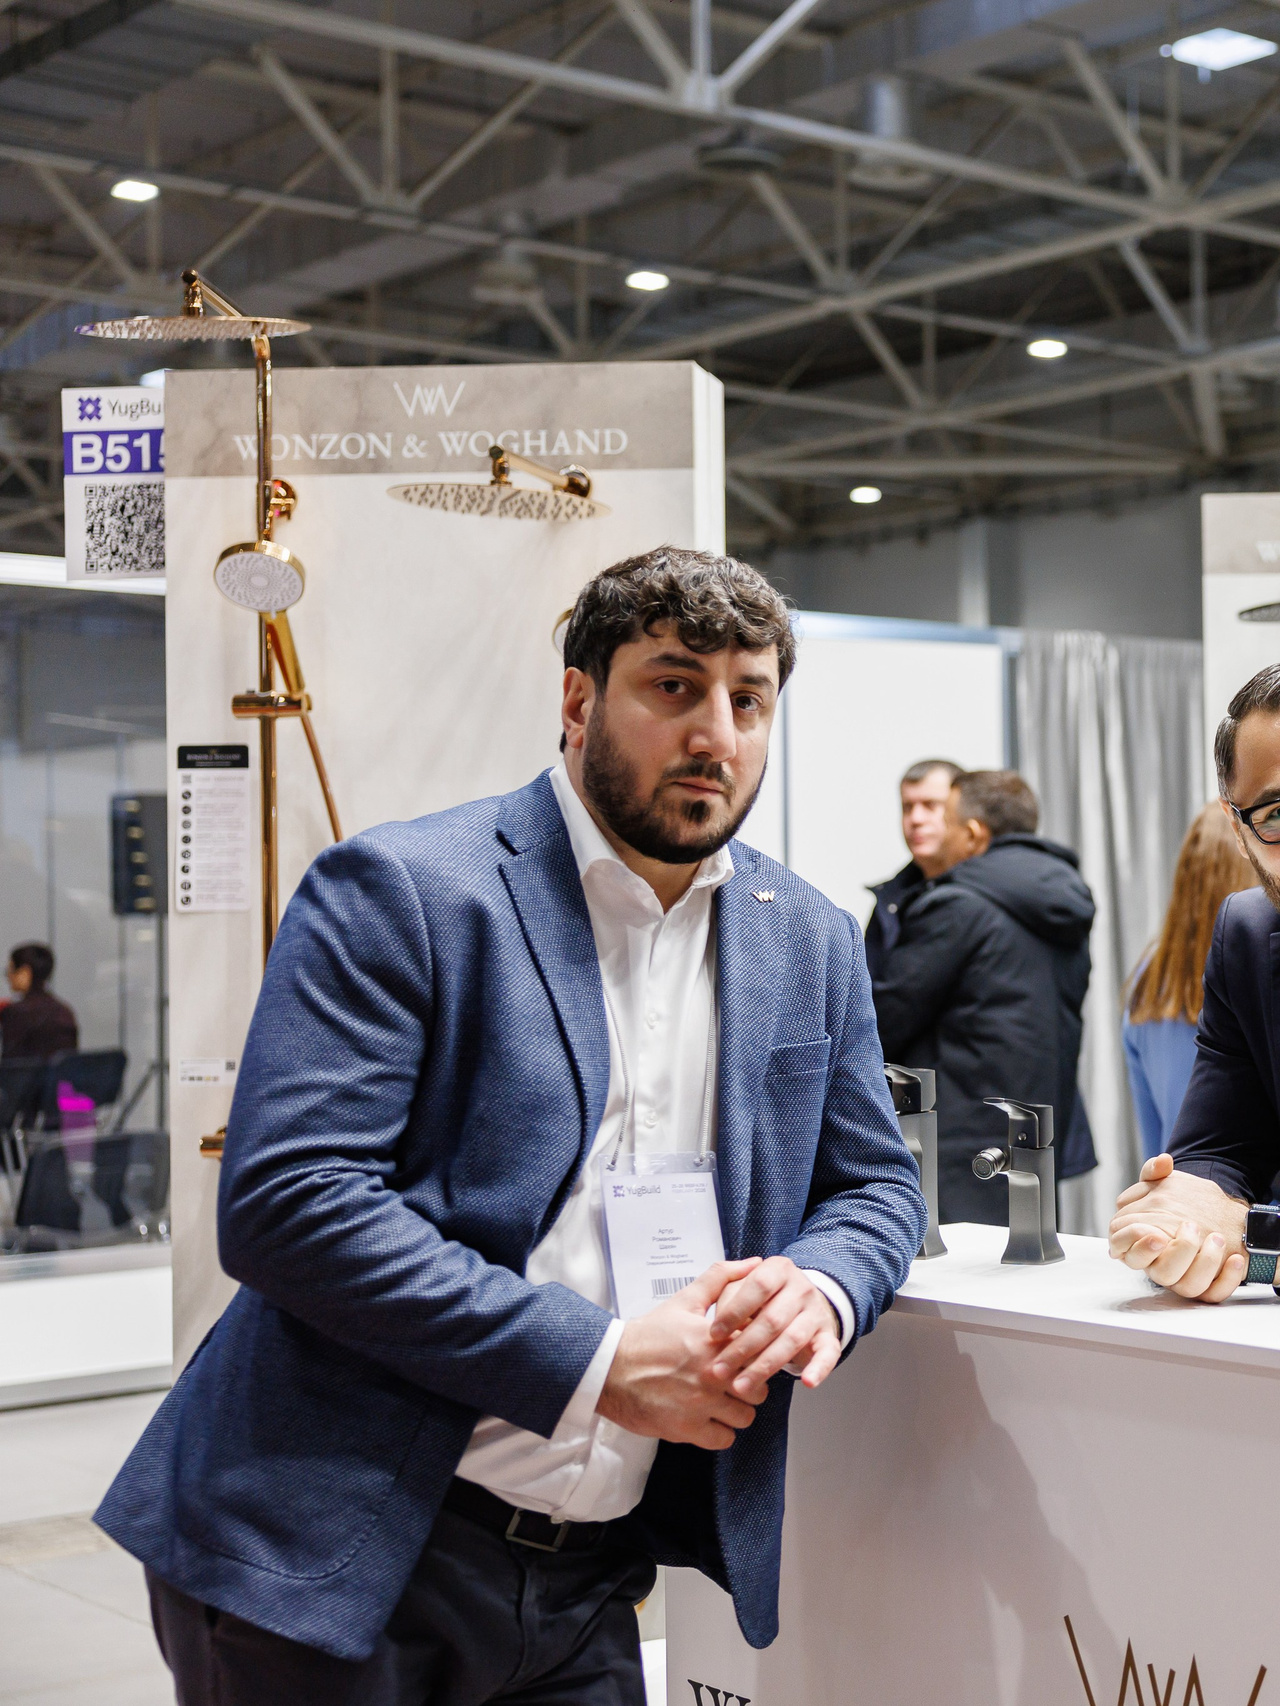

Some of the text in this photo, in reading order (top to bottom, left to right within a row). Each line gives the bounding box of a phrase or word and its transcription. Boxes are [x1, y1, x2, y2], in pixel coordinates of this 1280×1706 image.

[233, 427, 629, 461] WONZON & WOGHAND
[626, 1184, 661, 1198] YugBuild
